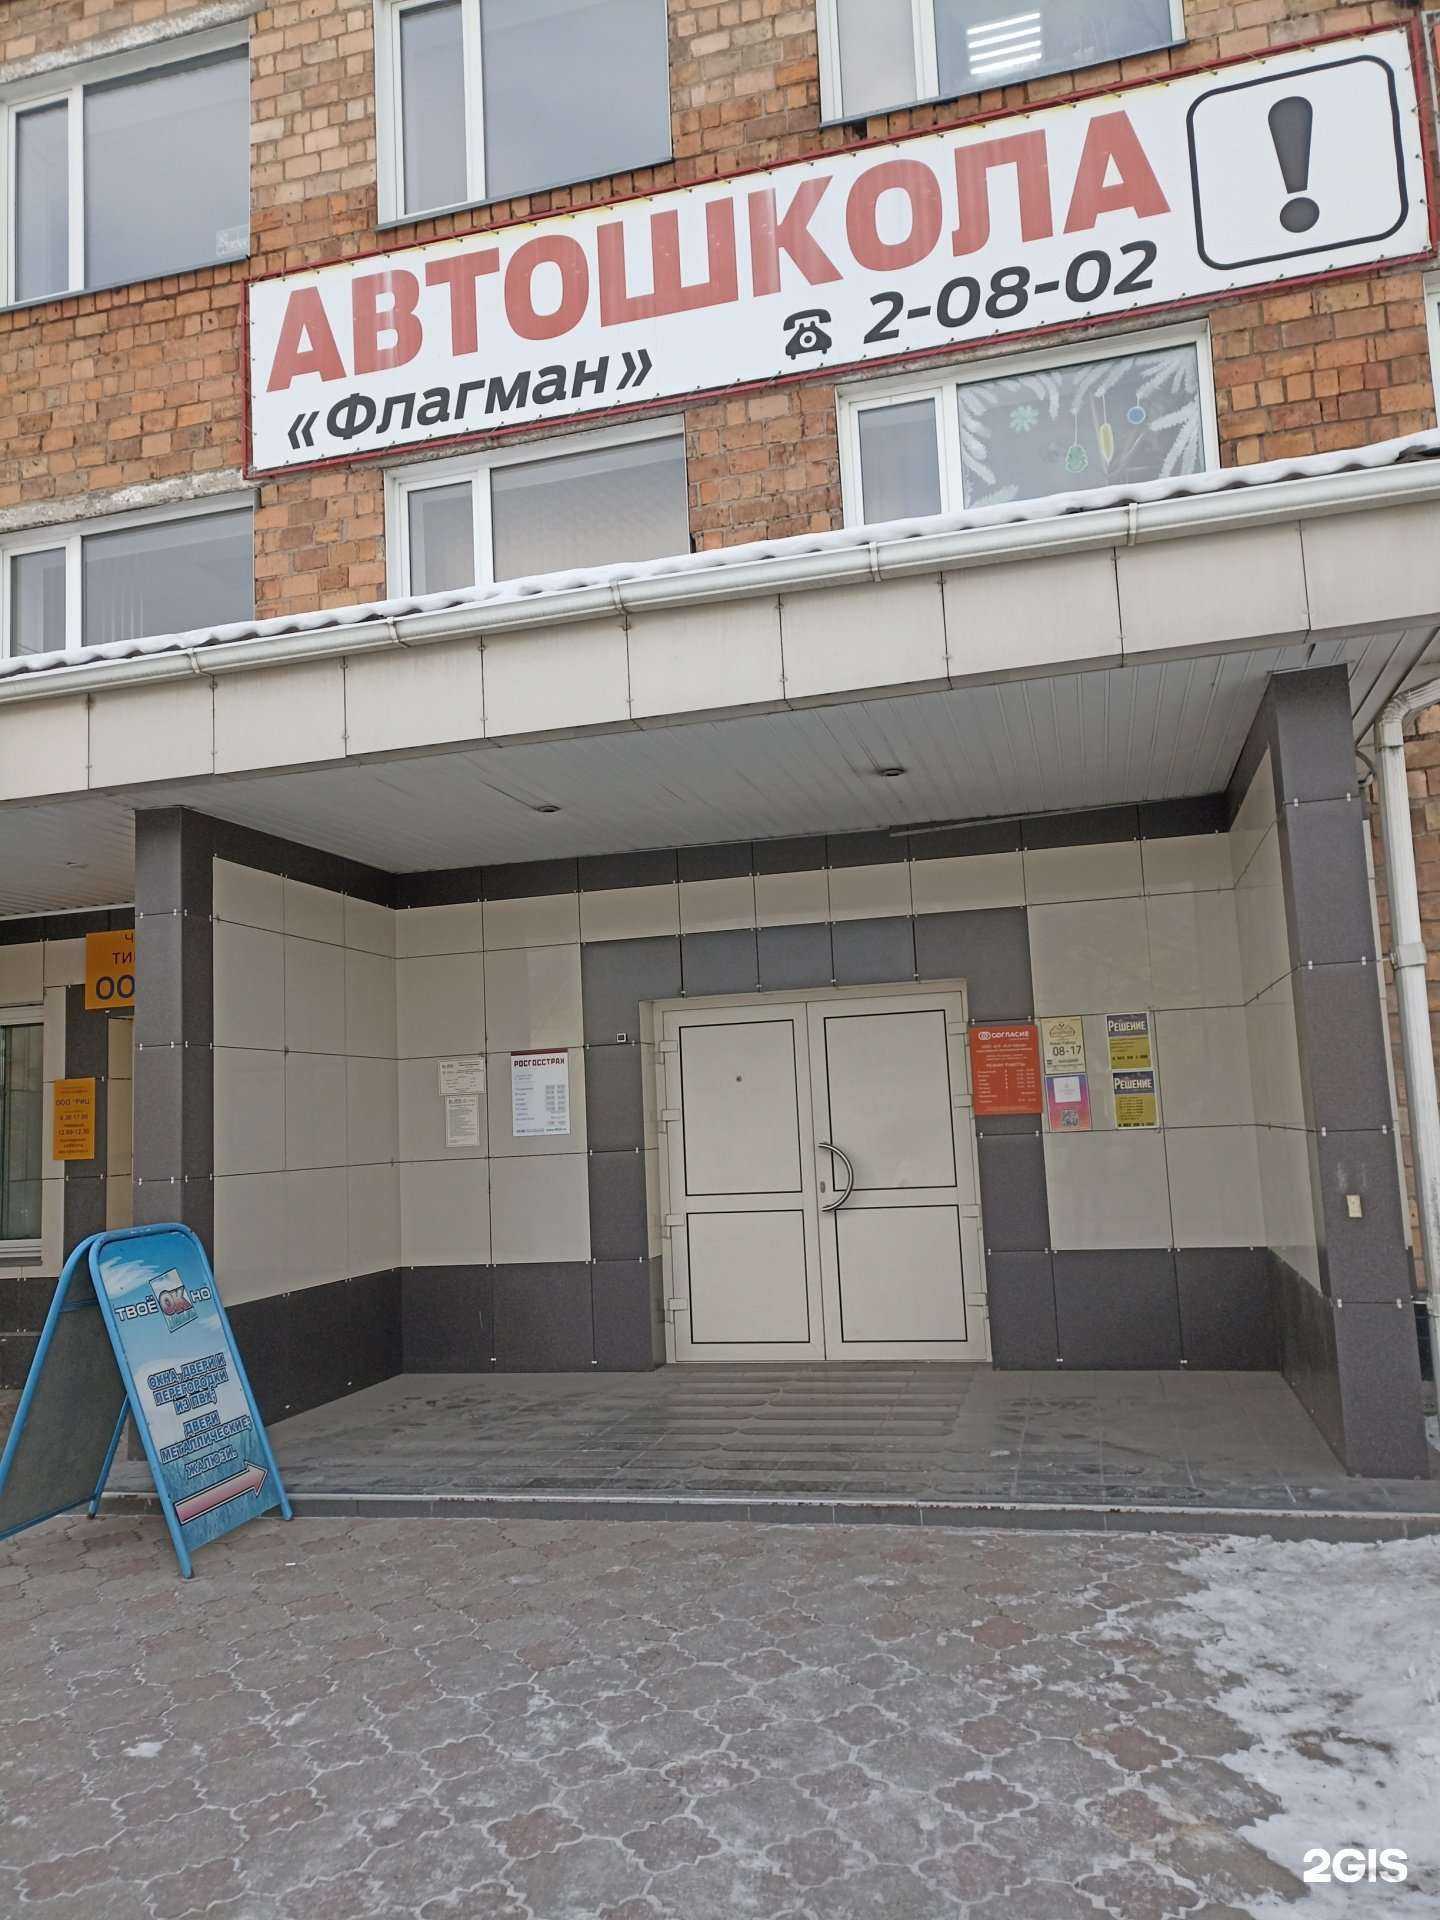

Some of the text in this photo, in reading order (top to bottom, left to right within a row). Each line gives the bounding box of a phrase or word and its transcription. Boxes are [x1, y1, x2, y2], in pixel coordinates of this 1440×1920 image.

[266, 110, 1171, 393] АВТОШКОЛА
[864, 239, 1157, 345] 2-08-02
[287, 348, 653, 450] «Флагман»
[513, 1057, 565, 1067] РОСГОССТРАХ
[114, 1297, 159, 1322] ТВОЁ
[181, 1355, 216, 1378] ДВЕРИ
[183, 1410, 221, 1438] ДВЕРИ
